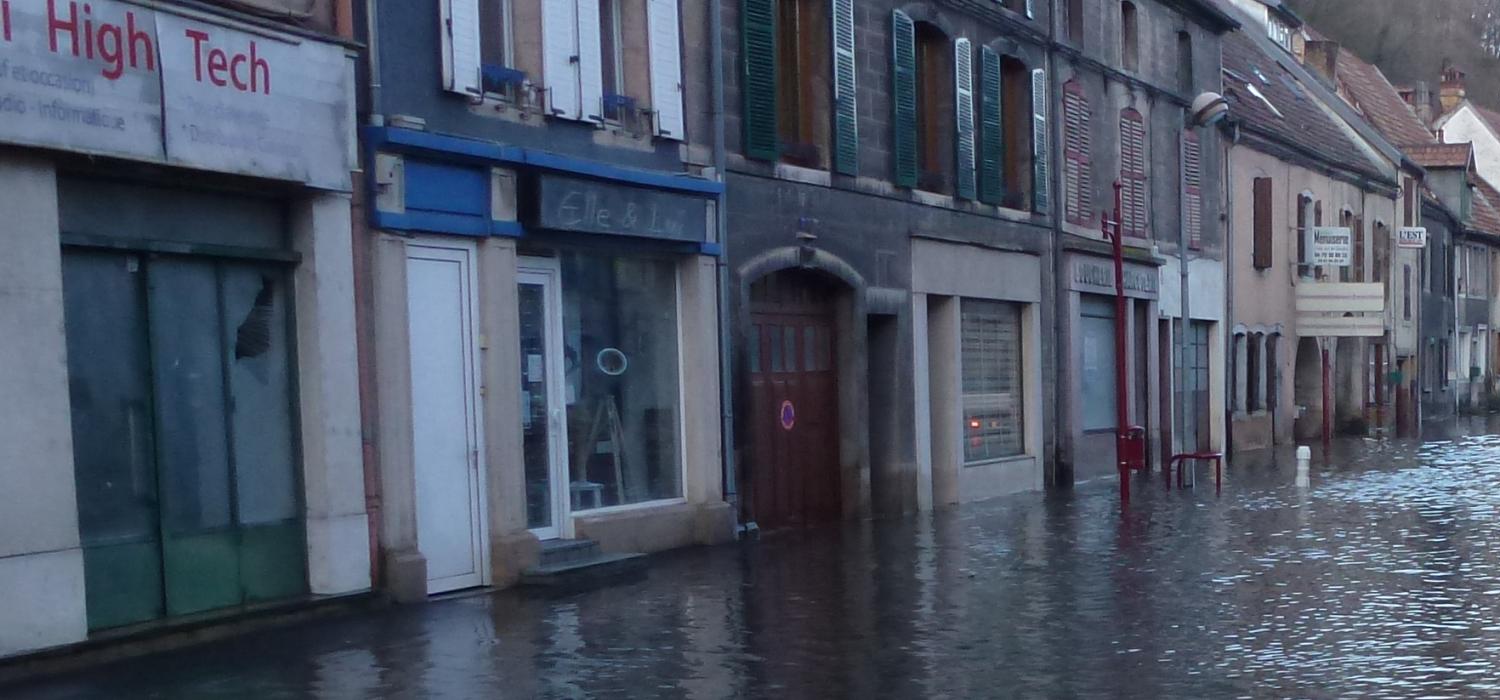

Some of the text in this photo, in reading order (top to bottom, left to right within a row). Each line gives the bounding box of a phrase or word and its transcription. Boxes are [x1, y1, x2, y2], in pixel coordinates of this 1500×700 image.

[47, 0, 154, 80] High
[185, 29, 270, 95] Tech
[558, 191, 611, 228] Elle
[623, 202, 637, 228] &
[1399, 231, 1423, 240] L'EST
